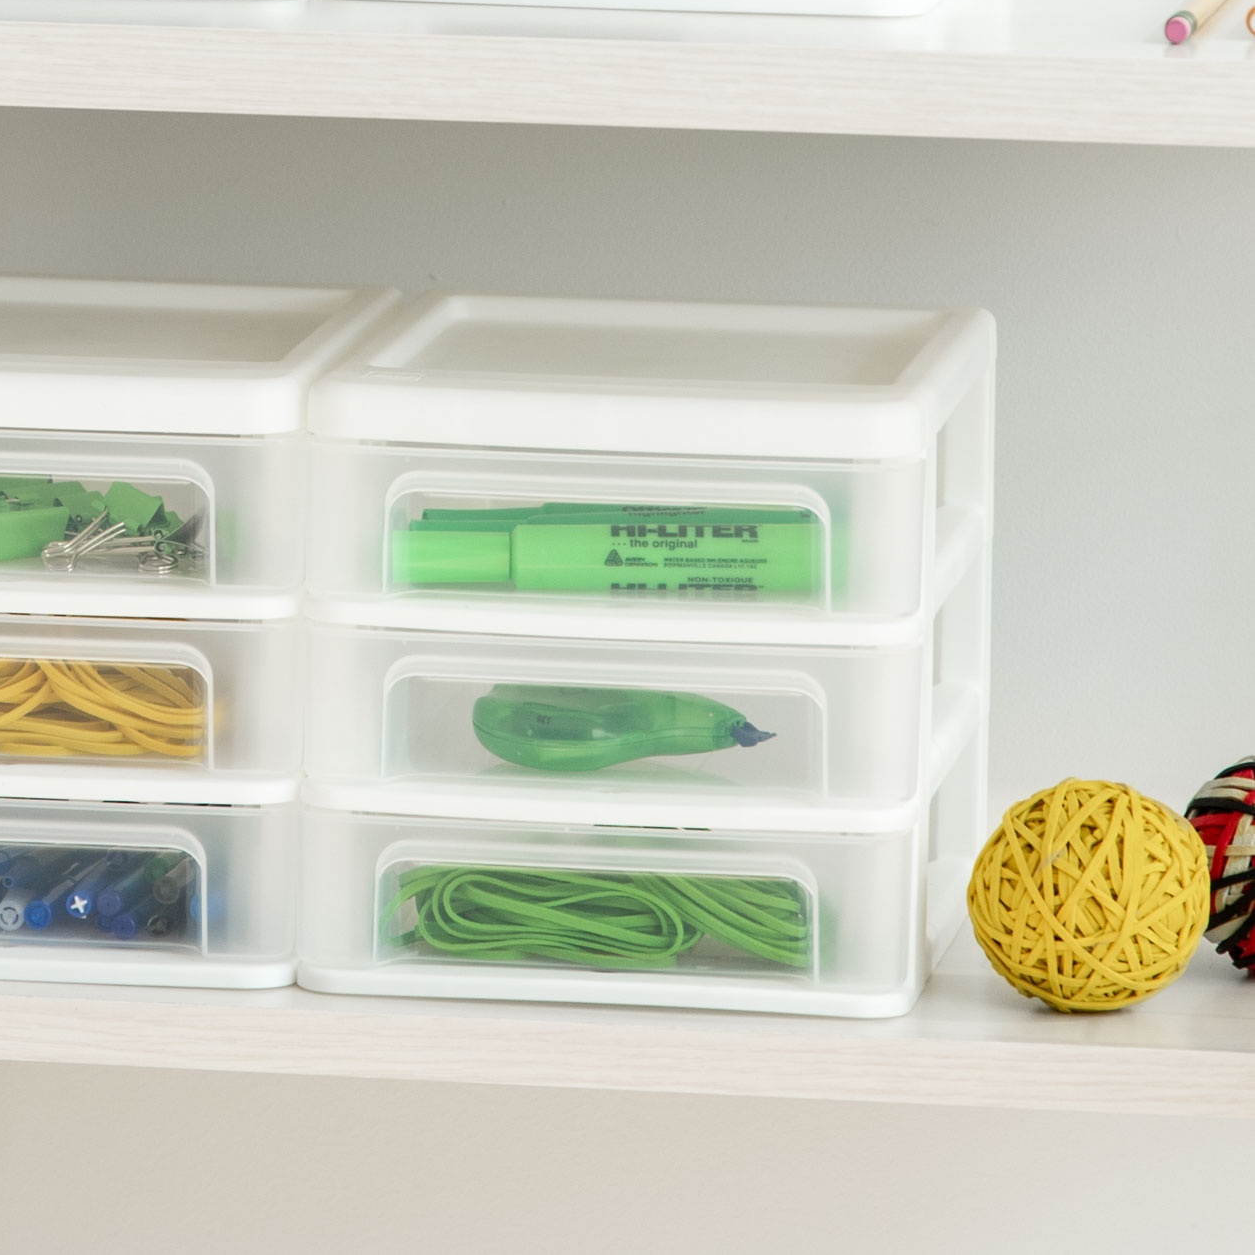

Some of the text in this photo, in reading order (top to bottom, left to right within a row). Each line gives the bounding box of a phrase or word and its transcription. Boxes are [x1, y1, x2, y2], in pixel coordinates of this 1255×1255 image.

[611, 524, 759, 539] HI-LITER
[629, 539, 649, 548] the
[652, 539, 698, 550] original
